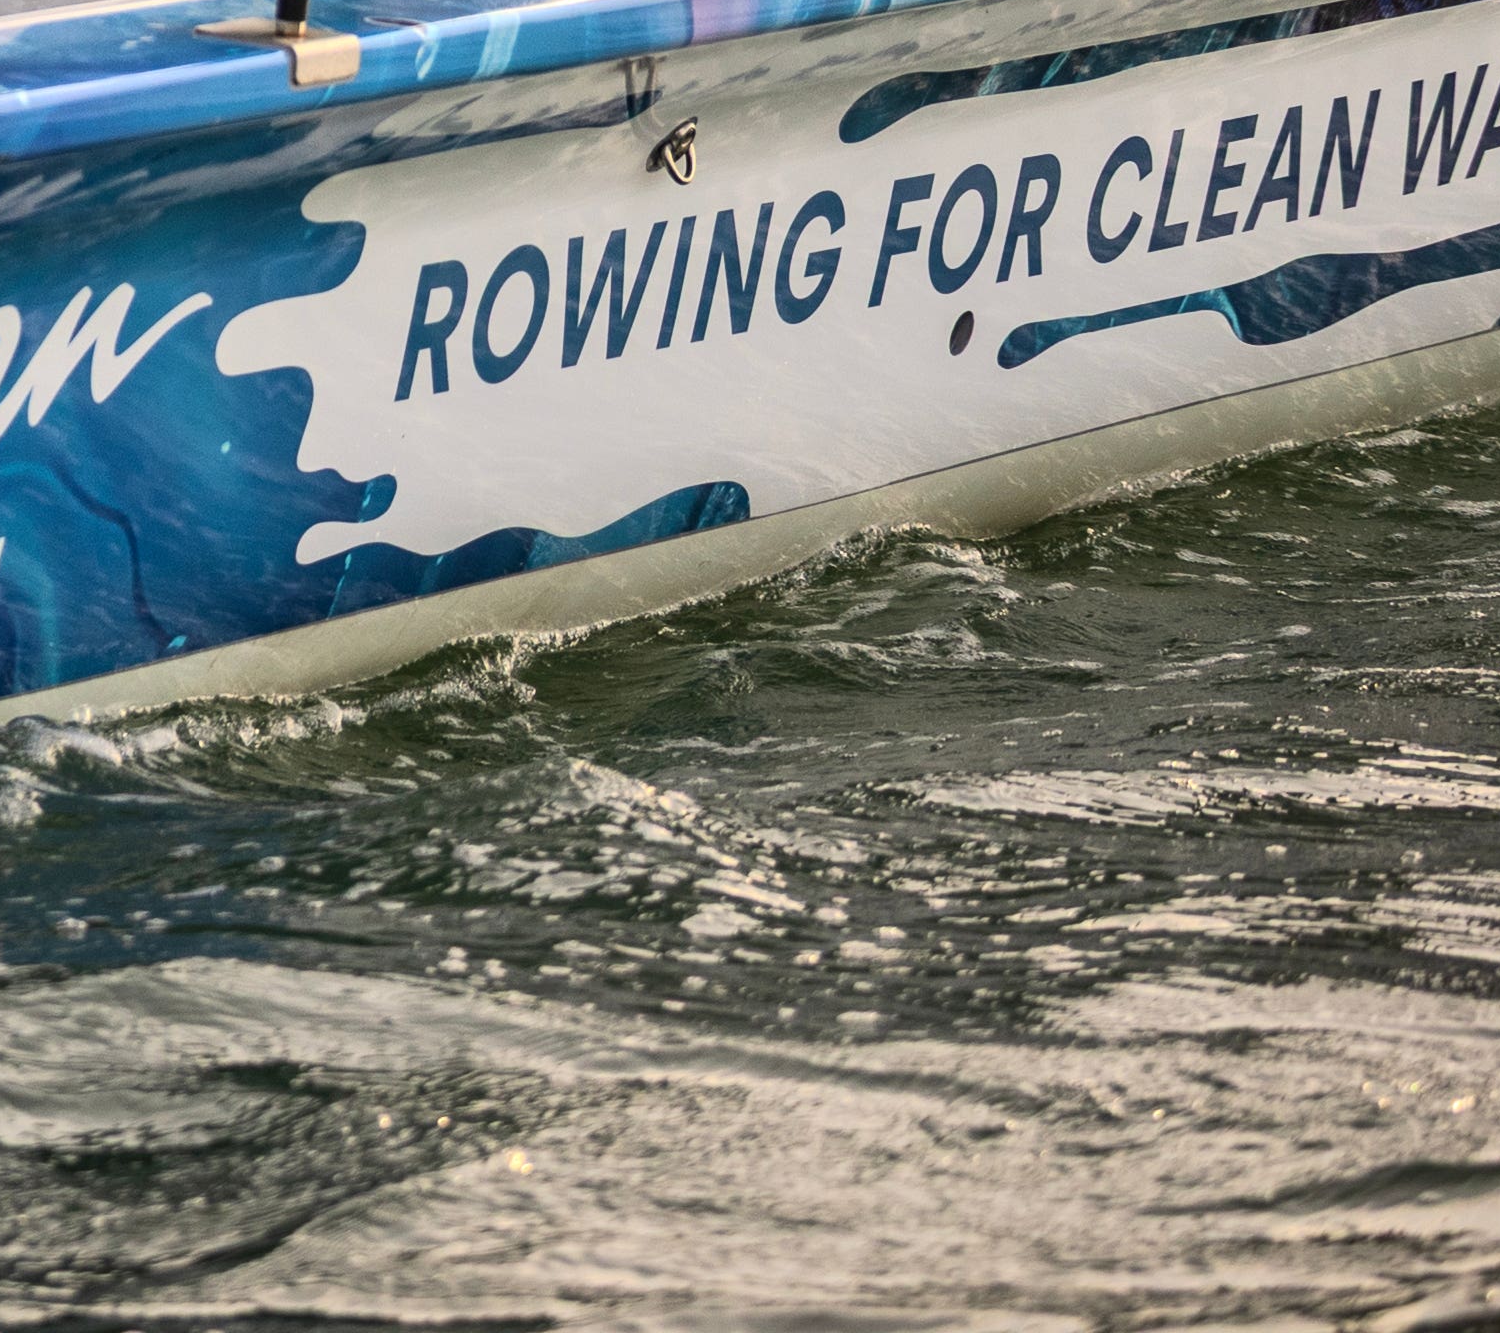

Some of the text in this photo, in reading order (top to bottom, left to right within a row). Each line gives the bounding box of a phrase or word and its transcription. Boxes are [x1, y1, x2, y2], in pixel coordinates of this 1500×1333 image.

[394, 190, 846, 403] ROWING
[867, 152, 1062, 309] FOR
[1086, 88, 1382, 265] CLEAN
